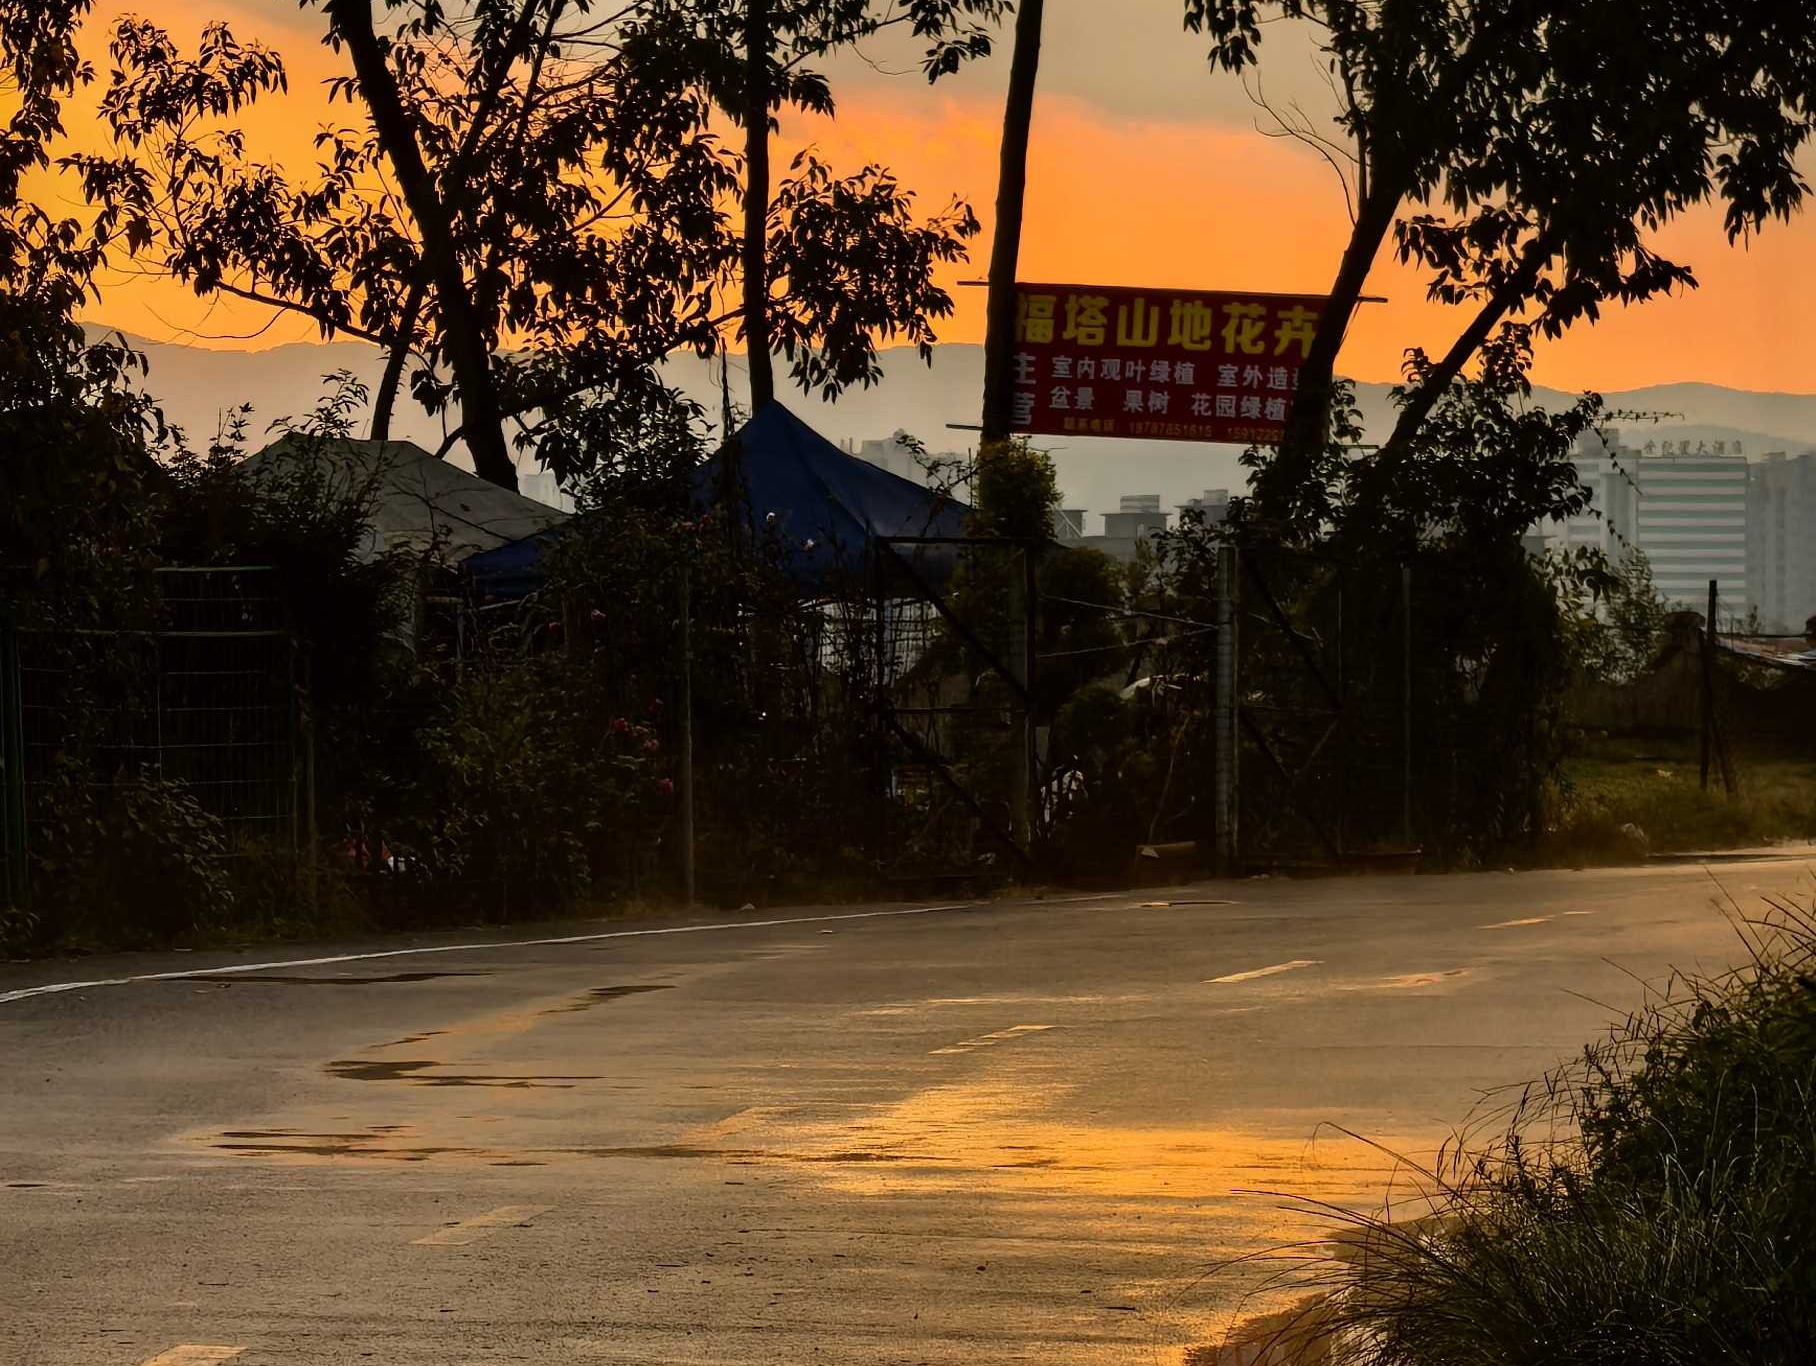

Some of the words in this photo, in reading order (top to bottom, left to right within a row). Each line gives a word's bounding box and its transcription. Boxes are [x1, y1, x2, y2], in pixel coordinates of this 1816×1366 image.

[1013, 291, 1320, 359] 福塔山地花卉
[1050, 355, 1196, 386] 室内观叶绿植
[1048, 385, 1095, 411] 盆景
[1122, 389, 1171, 416] 果树
[1190, 392, 1294, 422] 花园绿植
